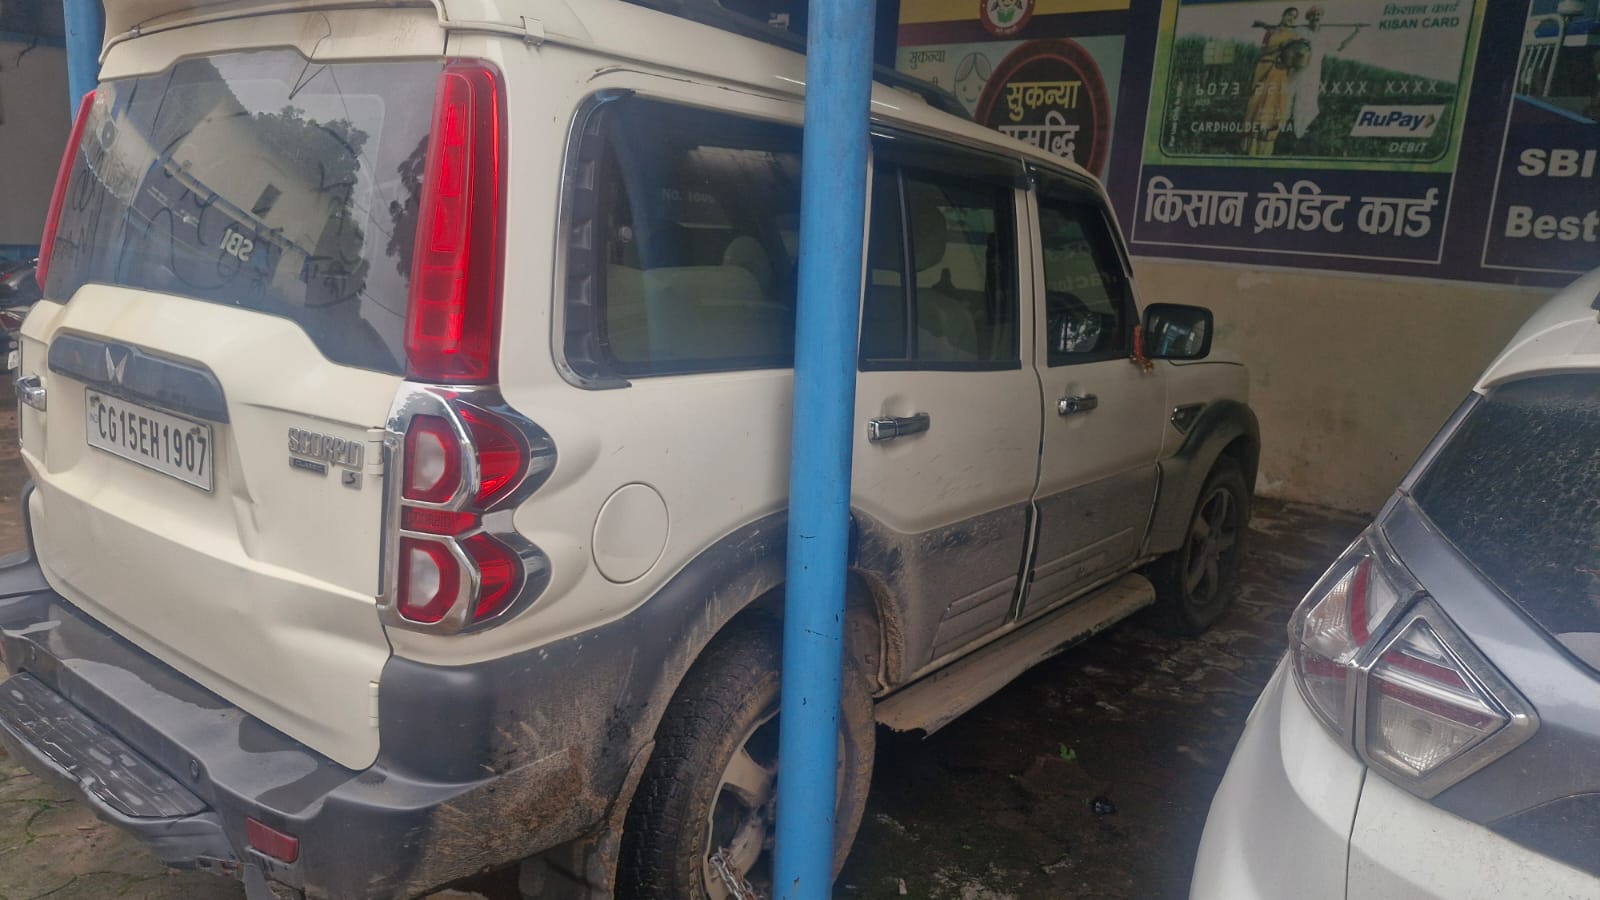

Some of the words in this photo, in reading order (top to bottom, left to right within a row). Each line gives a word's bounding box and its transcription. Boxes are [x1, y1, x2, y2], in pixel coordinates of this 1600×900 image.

[1379, 18, 1418, 31] KISAN
[1422, 17, 1460, 29] CARD
[1006, 80, 1082, 122] सुकन्या
[1384, 80, 1439, 96] XXXX
[1358, 111, 1426, 131] RuPay
[1388, 142, 1430, 154] DEBIT
[1517, 148, 1598, 177] SBI
[1144, 175, 1248, 229] किसान
[1254, 180, 1351, 233] क्रेडिट
[1357, 187, 1439, 238] कार्ड
[1504, 205, 1600, 242] Best
[98, 402, 207, 477] CG15EH1907
[288, 426, 365, 471] SCORPIO
[344, 472, 356, 485] S
